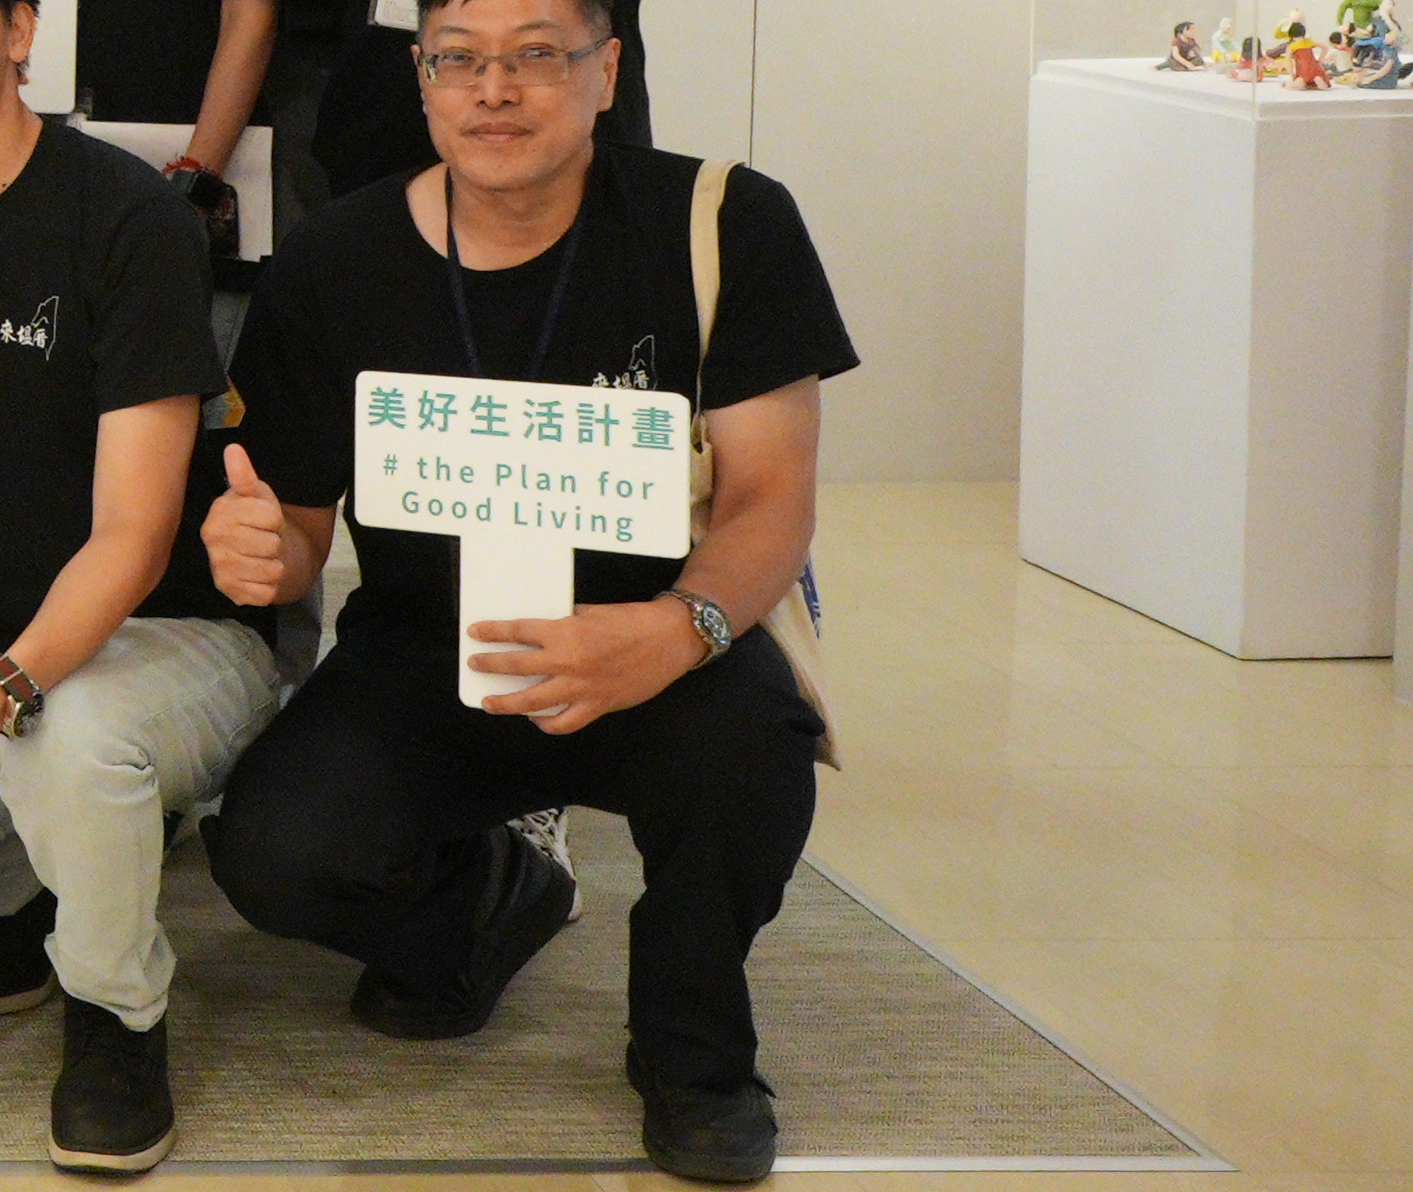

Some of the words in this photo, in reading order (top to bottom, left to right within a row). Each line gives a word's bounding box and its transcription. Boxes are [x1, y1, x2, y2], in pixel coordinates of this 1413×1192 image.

[367, 386, 676, 451] 美好生活計畫
[417, 456, 476, 484] the
[495, 462, 578, 494] Plan
[597, 470, 656, 501] for
[401, 490, 493, 523] Good
[514, 501, 635, 543] Living
